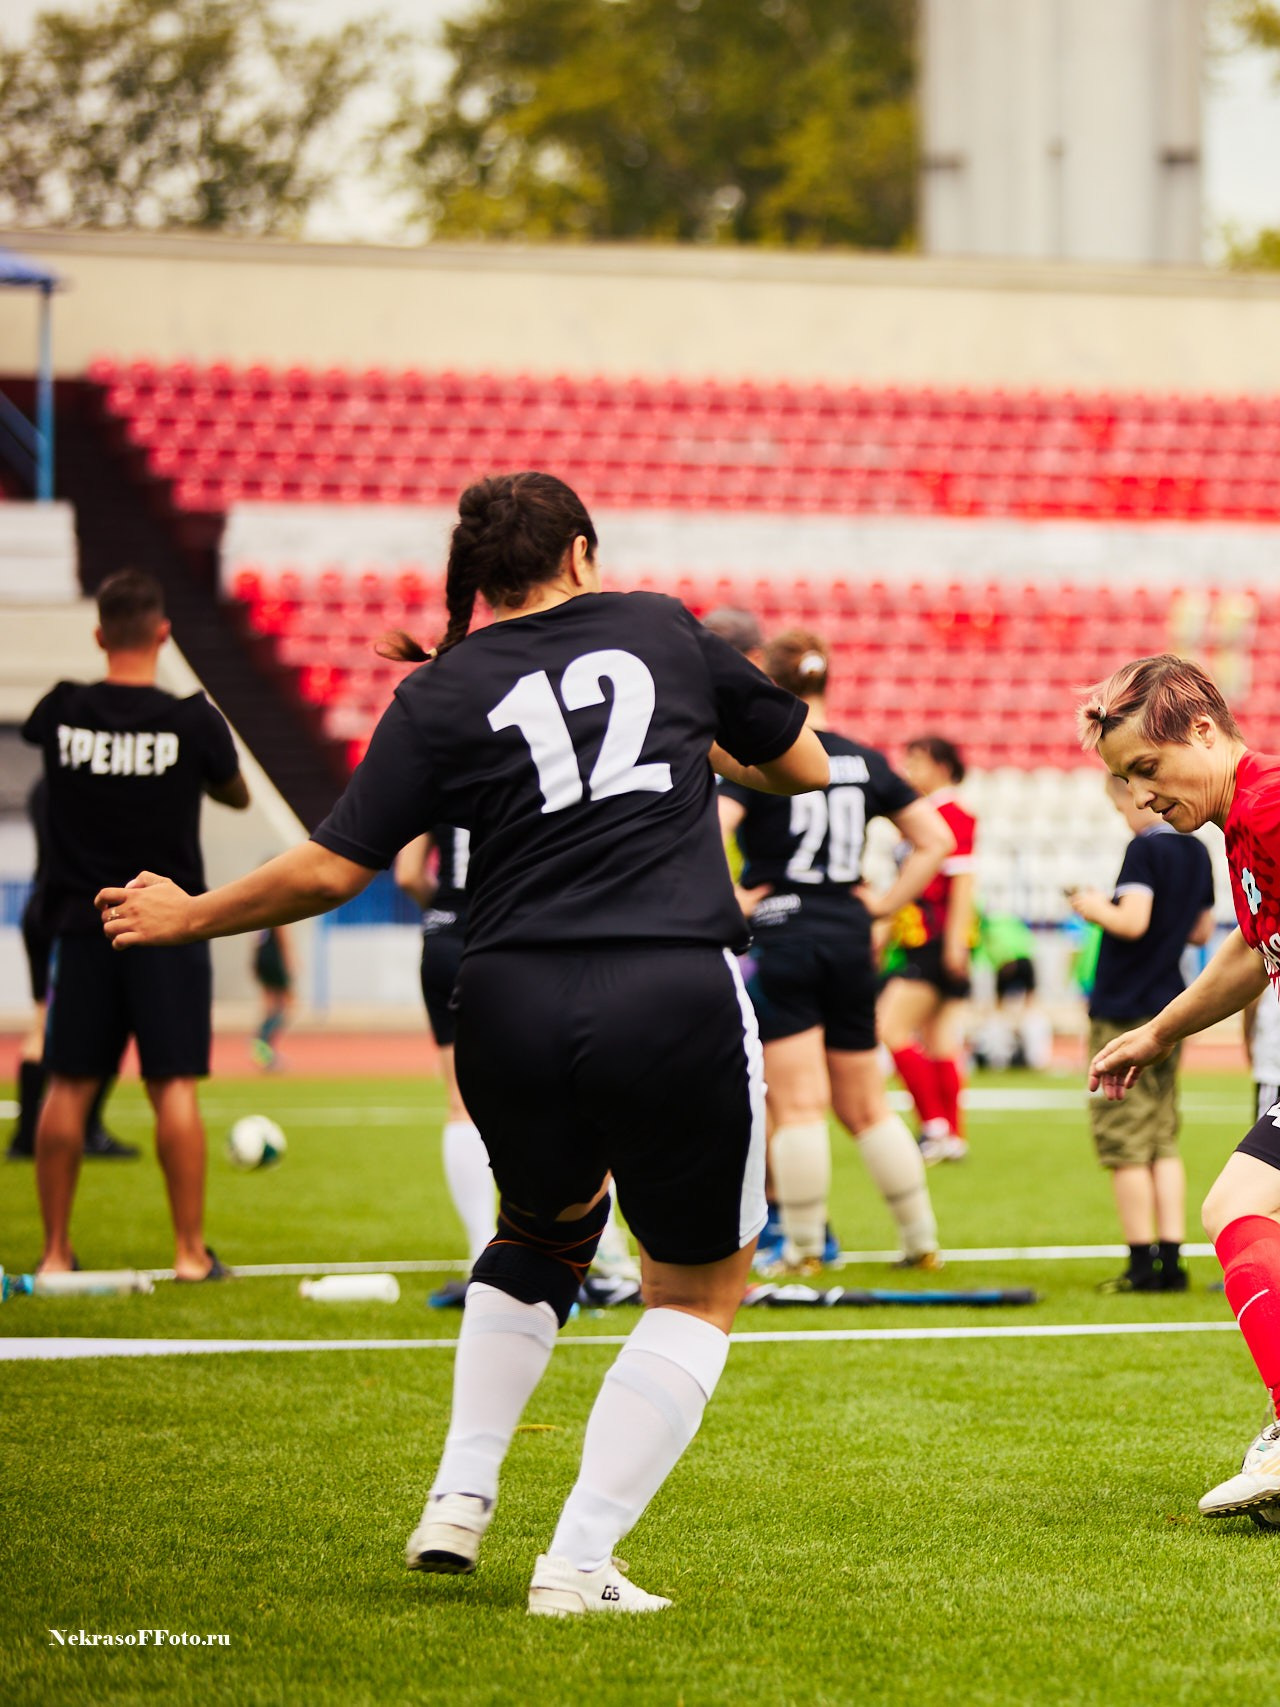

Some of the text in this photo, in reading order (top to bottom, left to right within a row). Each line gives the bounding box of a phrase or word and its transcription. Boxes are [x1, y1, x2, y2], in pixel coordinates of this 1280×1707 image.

[57, 724, 179, 775] ТРЕНЕР
[487, 649, 673, 814] 12
[786, 786, 866, 884] 20
